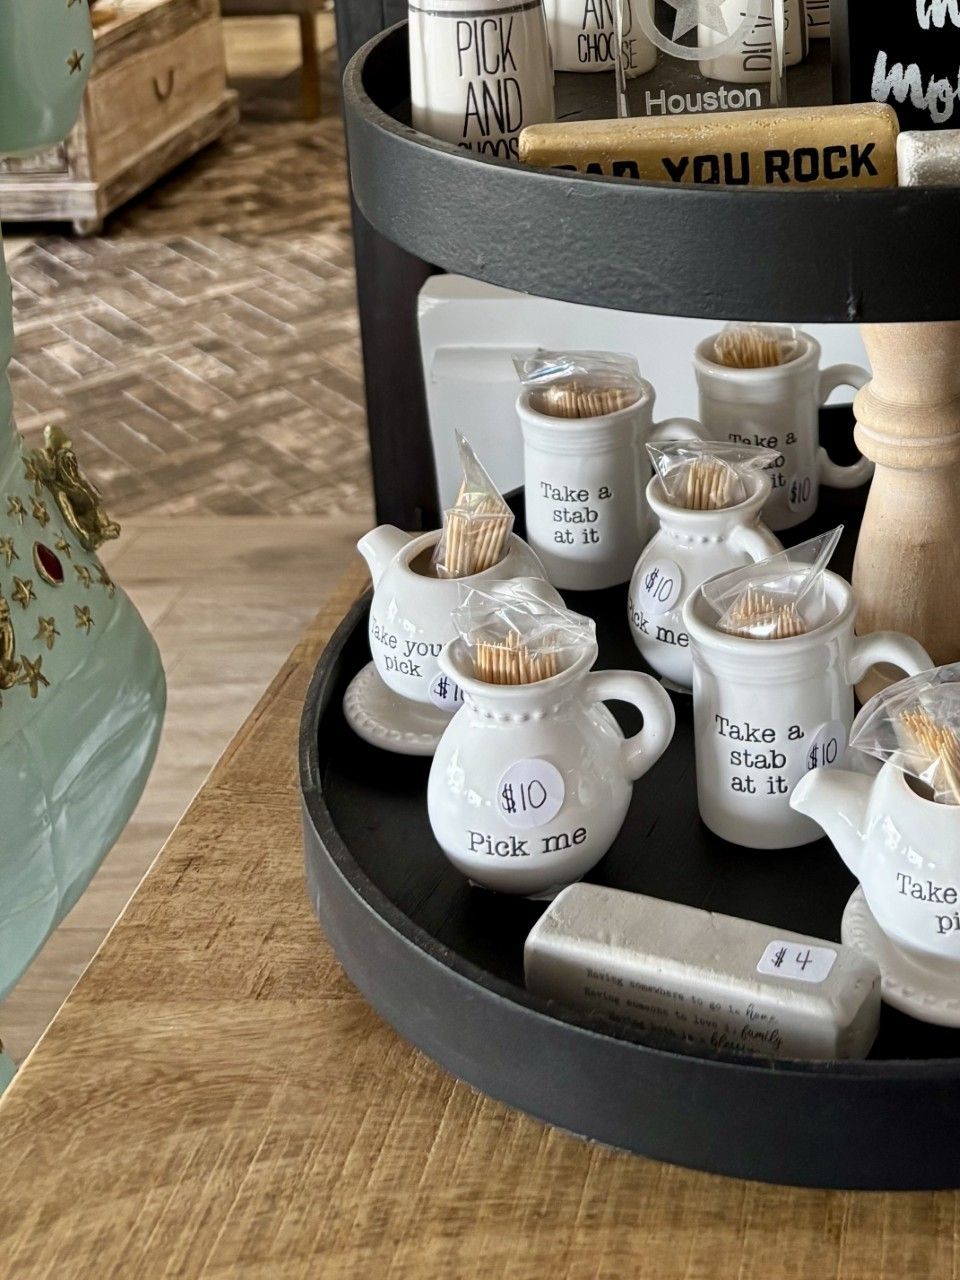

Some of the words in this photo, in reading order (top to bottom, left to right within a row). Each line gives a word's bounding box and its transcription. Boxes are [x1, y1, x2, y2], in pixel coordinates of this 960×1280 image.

[456, 18, 518, 77] PICK
[462, 77, 524, 139] AND
[645, 85, 762, 116] Houston
[661, 152, 750, 185] YOU
[764, 143, 878, 184] ROCK
[785, 432, 797, 445] a
[540, 481, 589, 502] Take
[597, 484, 613, 500] a
[771, 472, 786, 489] it
[790, 476, 811, 505] $10
[552, 505, 599, 524] stab
[553, 529, 575, 545] at
[582, 528, 600, 544] it
[644, 567, 674, 602] $10
[403, 639, 446, 658] you
[655, 624, 690, 648] me
[383, 654, 423, 678] pick
[715, 714, 776, 744] Take
[787, 724, 805, 741] a
[729, 749, 788, 769] stab
[807, 737, 838, 771] $10
[501, 779, 547, 814] $10
[731, 775, 756, 794] at
[766, 775, 789, 795] it
[467, 829, 530, 858] Pick
[541, 825, 588, 854] me
[896, 872, 958, 905] Take
